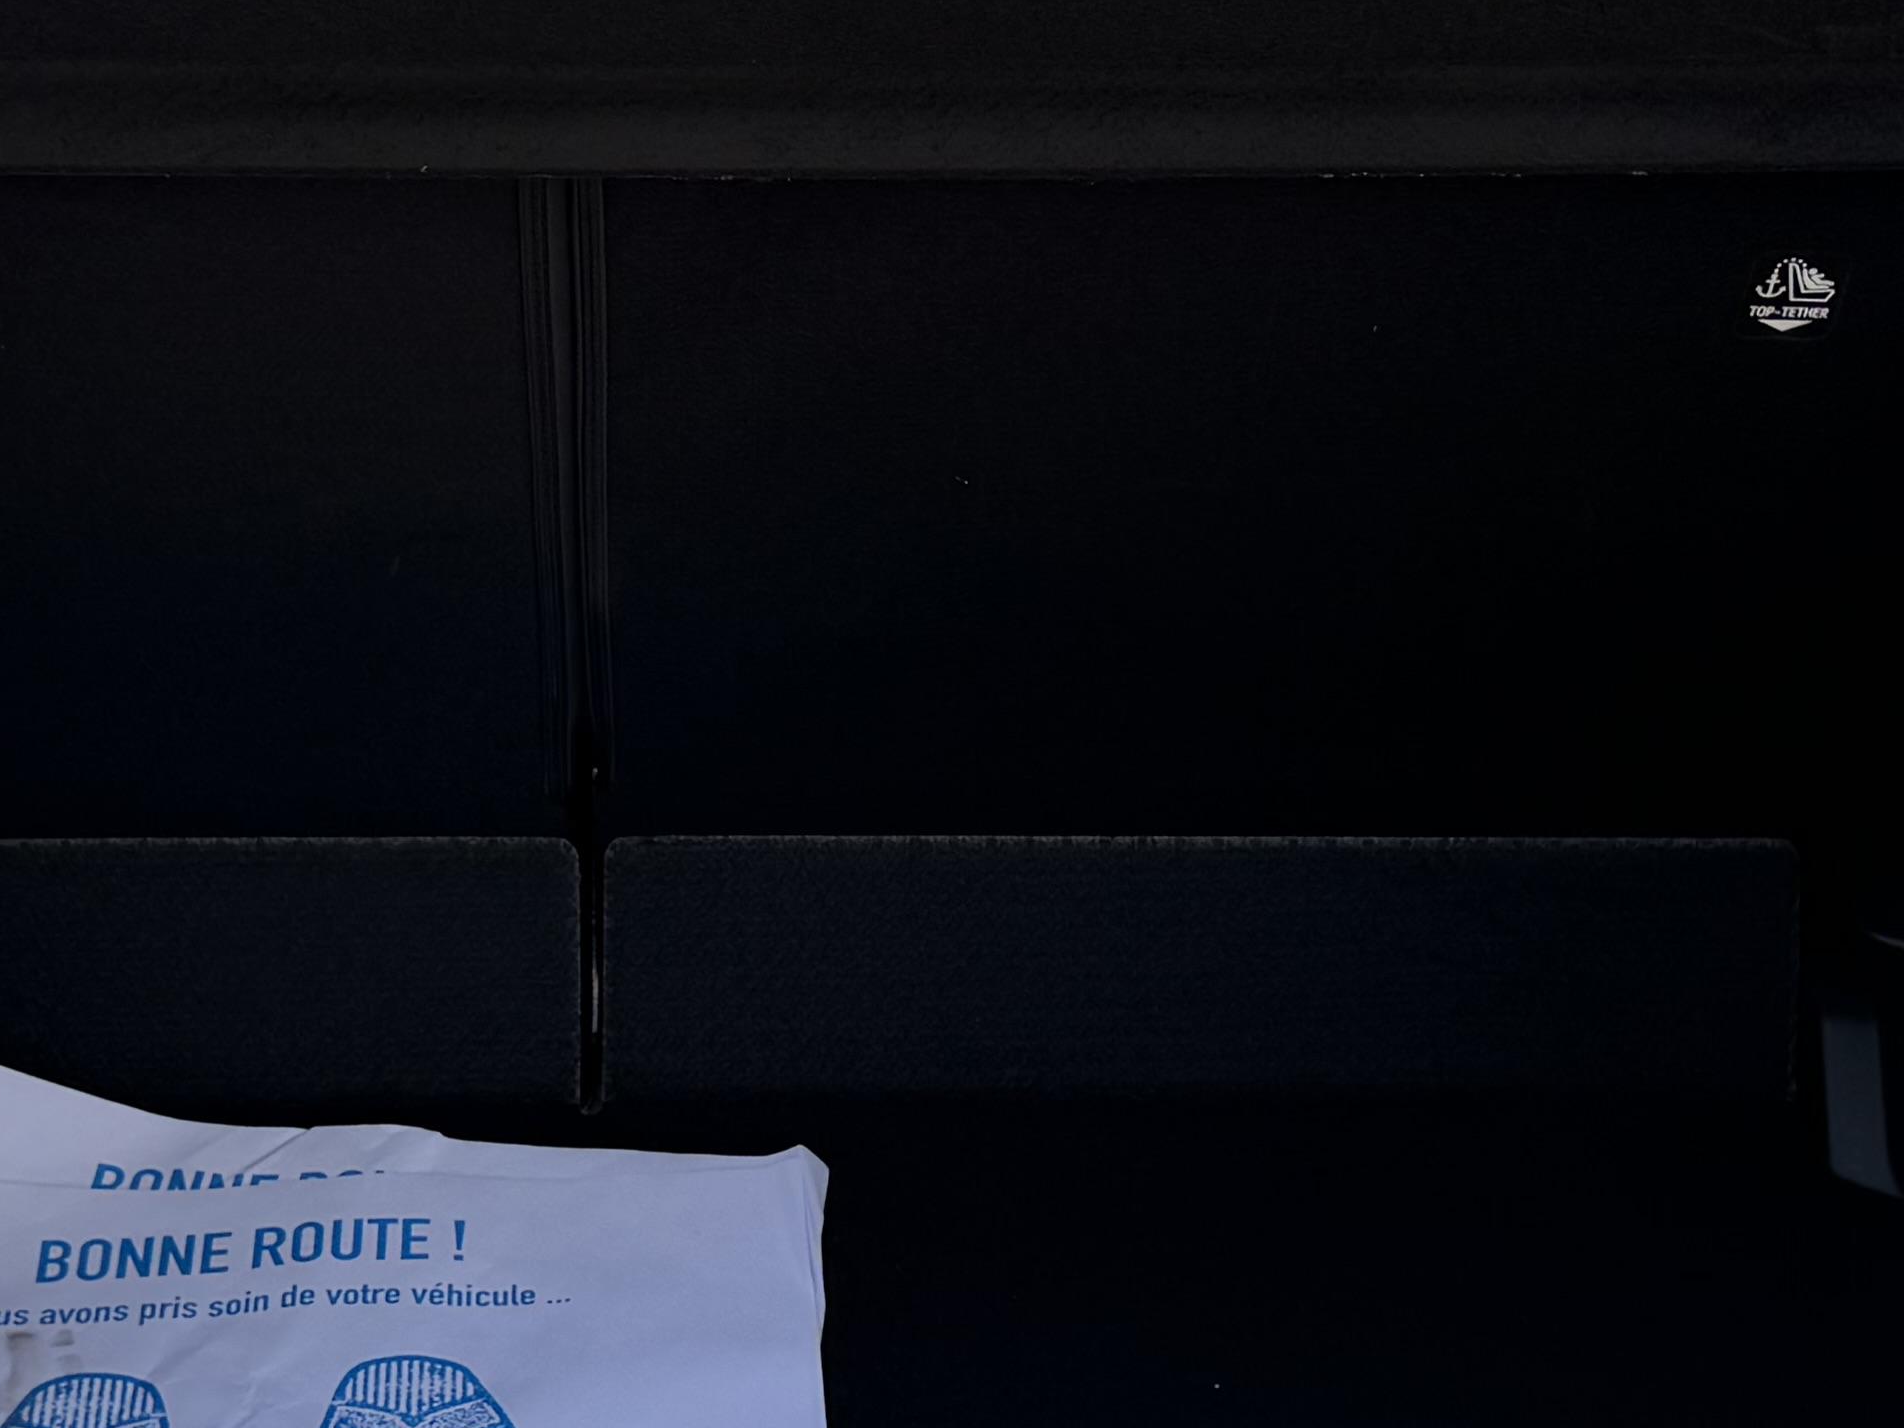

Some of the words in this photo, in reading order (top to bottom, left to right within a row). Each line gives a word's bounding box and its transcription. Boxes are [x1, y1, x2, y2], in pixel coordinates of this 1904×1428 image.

[1749, 305, 1830, 319] TOP-TETHER
[34, 1231, 234, 1284] BONNE
[250, 1217, 432, 1270] ROUTE
[39, 1304, 129, 1325] avons
[138, 1296, 198, 1326] pris
[208, 1290, 270, 1319] soin
[280, 1284, 316, 1308] de
[325, 1283, 401, 1306] votre
[411, 1282, 537, 1307] véhicule
